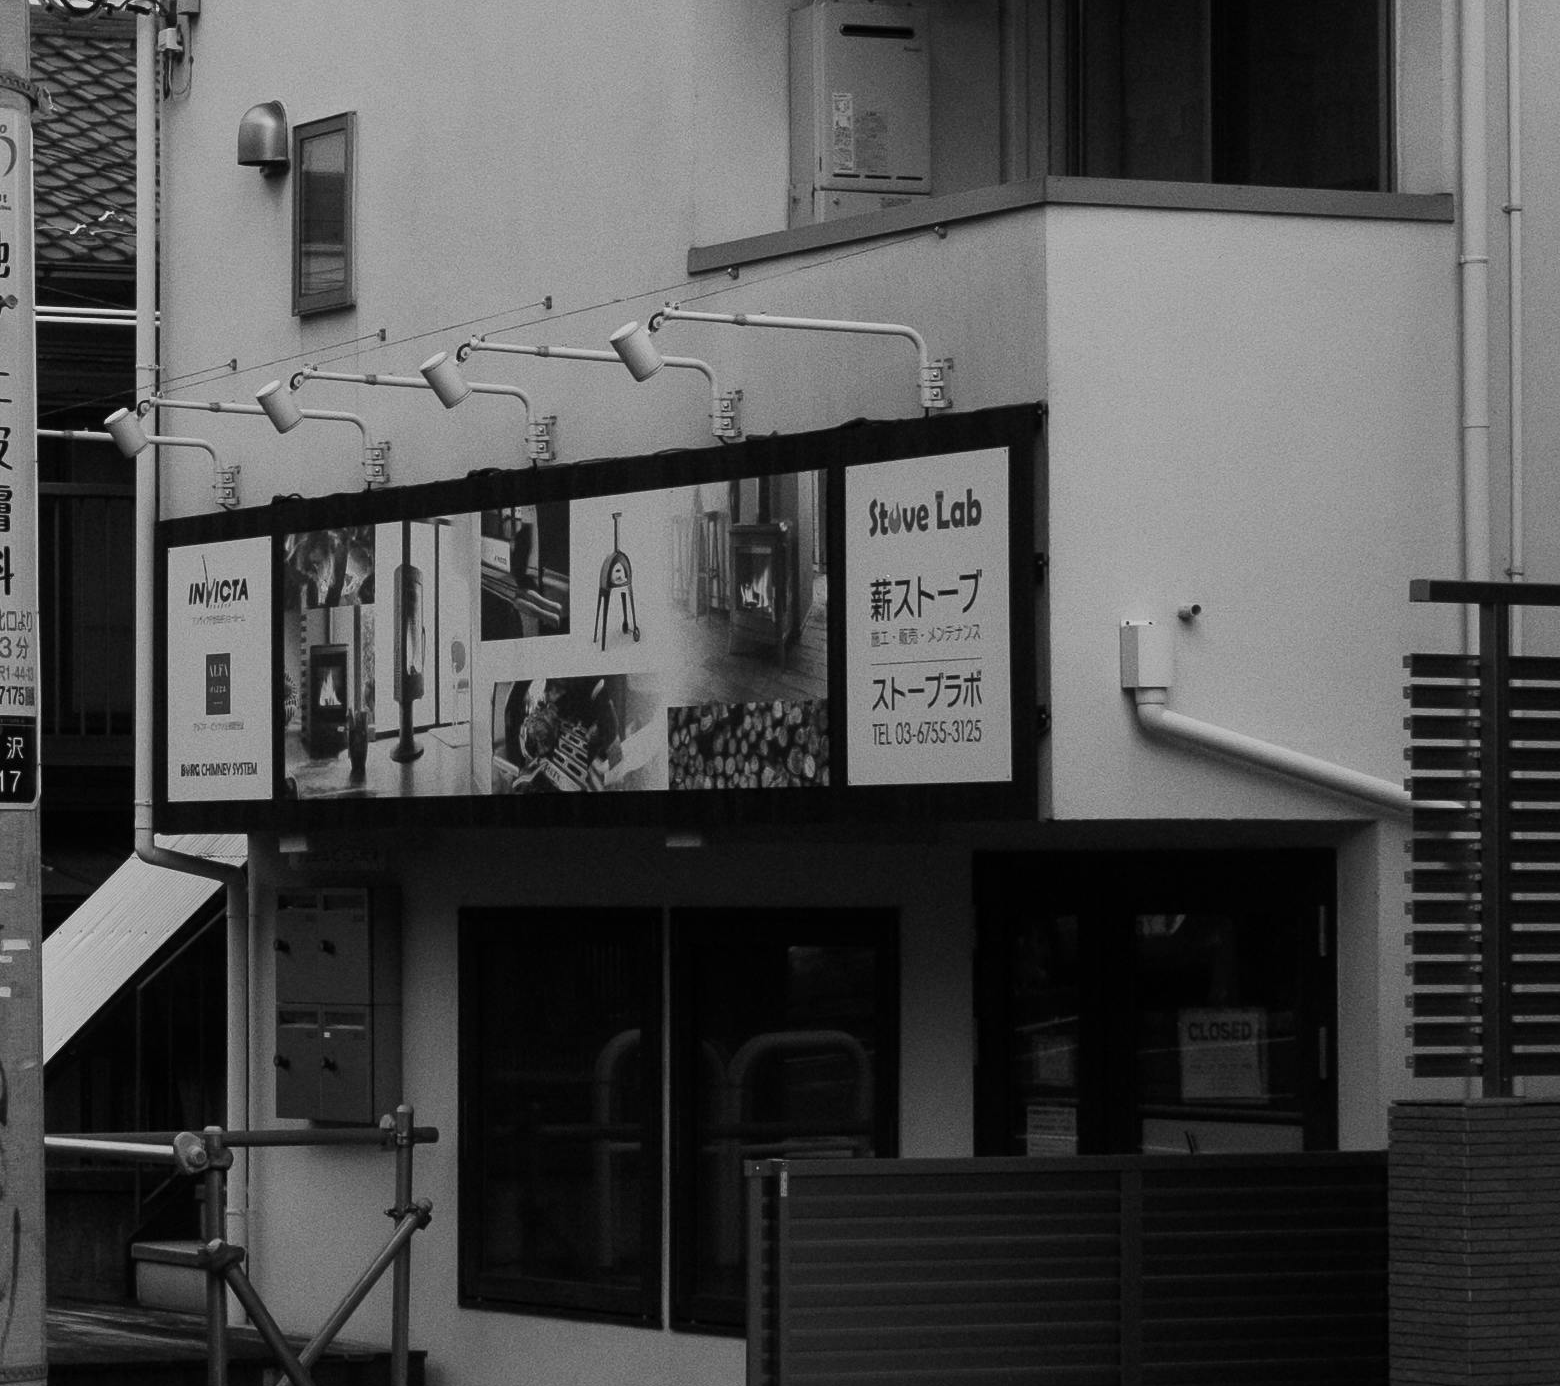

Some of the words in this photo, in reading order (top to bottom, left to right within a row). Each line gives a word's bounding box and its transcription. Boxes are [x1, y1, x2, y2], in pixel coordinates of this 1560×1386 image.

[935, 488, 982, 530] Lab
[188, 556, 249, 608] INVICTA
[870, 569, 982, 622] 薪ストーブ
[871, 670, 982, 711] ストーブラボ
[872, 723, 892, 746] TEL
[895, 719, 982, 745] 03-6755-3125
[201, 763, 231, 777] CHIMNEY
[232, 762, 258, 775] SYSTEM
[1188, 1021, 1252, 1041] CLOSED
